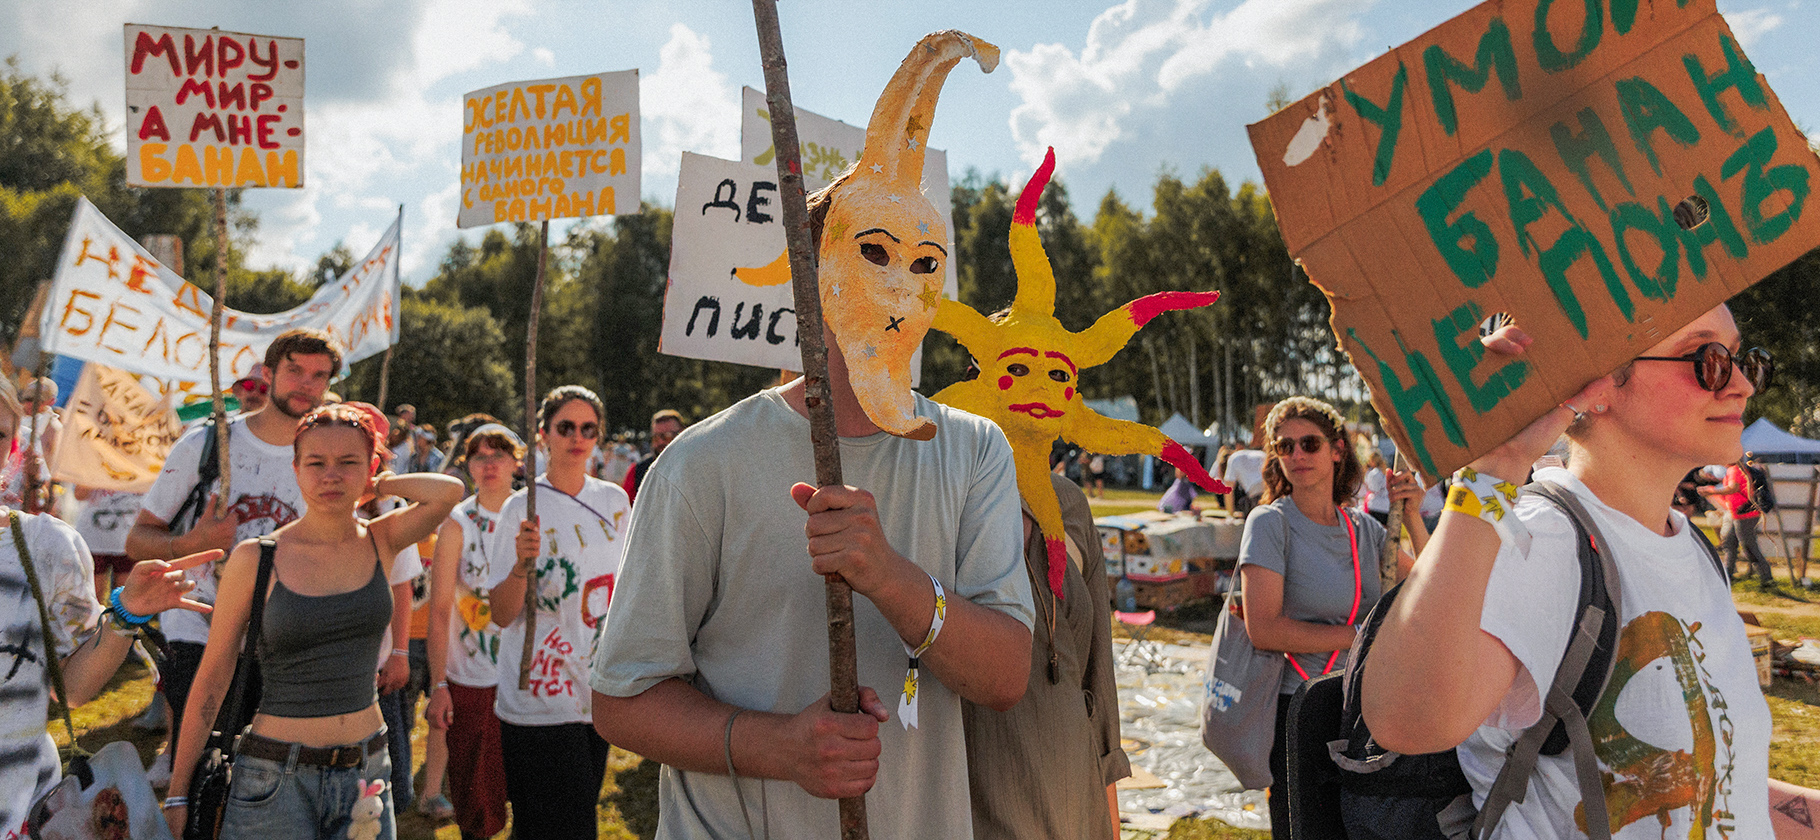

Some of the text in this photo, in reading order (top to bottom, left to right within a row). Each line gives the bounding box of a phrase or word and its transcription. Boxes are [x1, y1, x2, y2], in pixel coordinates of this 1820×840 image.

[130, 31, 299, 82] МИРУ-
[464, 77, 602, 134] ЖЕЛТАЯ
[1340, 0, 1693, 187] УМО
[138, 105, 301, 149] А МНЕ-
[474, 112, 630, 156] РЕВОЛЮЦИЯ
[140, 142, 298, 188] БАНАН
[461, 148, 627, 185] НАЧИНАЕТСЯ
[1414, 30, 1771, 289] БАНАН
[463, 177, 566, 210] С ОДНОГО
[494, 186, 616, 223] БАНАНА
[685, 295, 800, 347] ПИС
[1347, 300, 1533, 480] НЕ
